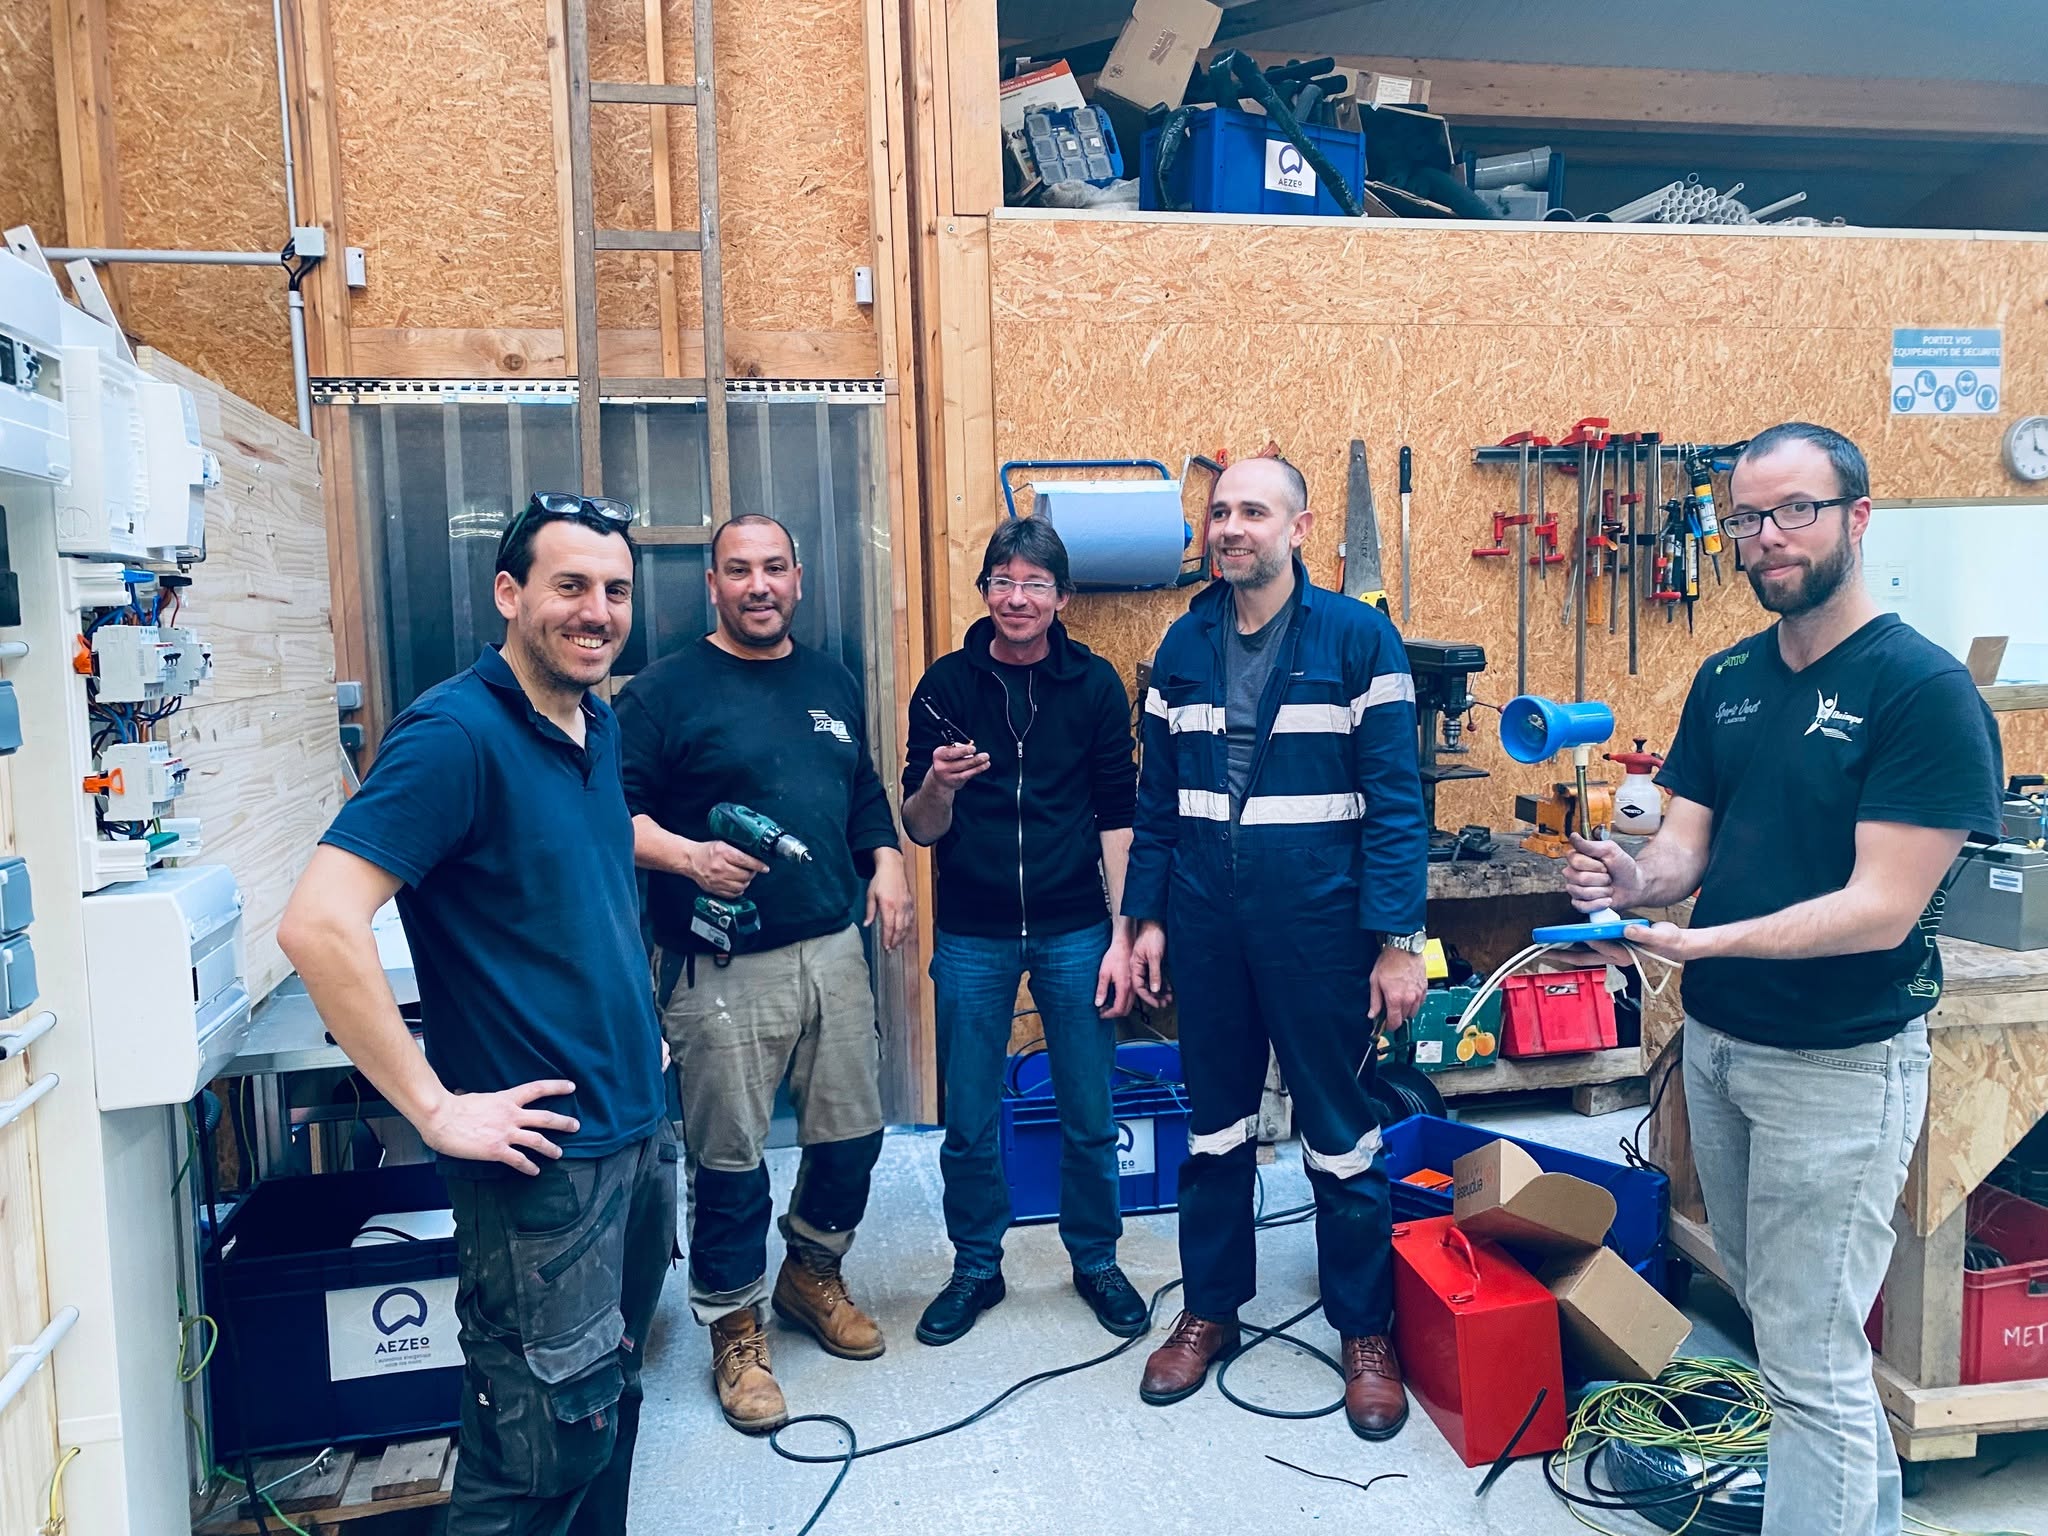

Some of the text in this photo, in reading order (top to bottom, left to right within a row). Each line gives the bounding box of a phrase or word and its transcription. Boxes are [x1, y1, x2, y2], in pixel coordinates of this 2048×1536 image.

[1278, 178, 1303, 187] AEZEO
[1922, 335, 1973, 345] PORTEZ VOS
[1950, 348, 1961, 356] DE
[375, 1336, 430, 1355] AEZEO
